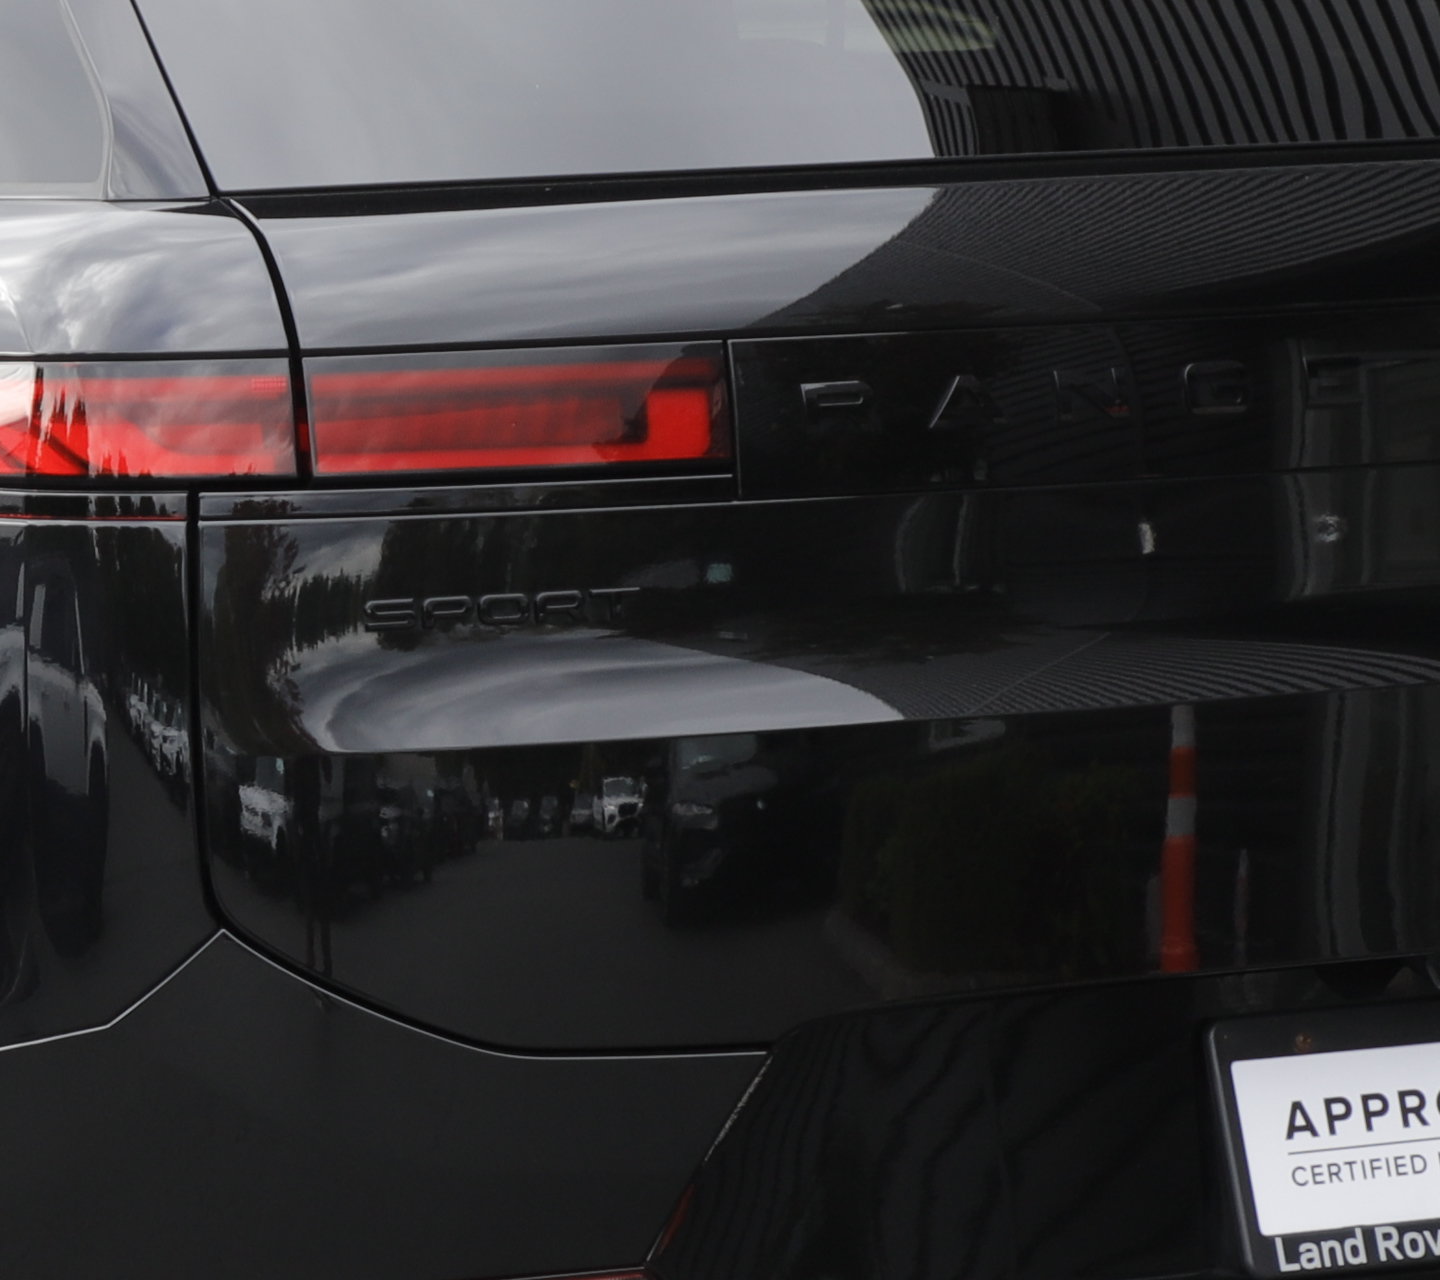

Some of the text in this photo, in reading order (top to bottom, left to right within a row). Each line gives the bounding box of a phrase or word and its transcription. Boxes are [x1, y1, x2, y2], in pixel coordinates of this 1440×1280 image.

[799, 356, 1363, 429] RANGE
[363, 586, 641, 632] SPORT
[1291, 1154, 1428, 1187] CERTIFIED
[1274, 1227, 1368, 1273] Land
